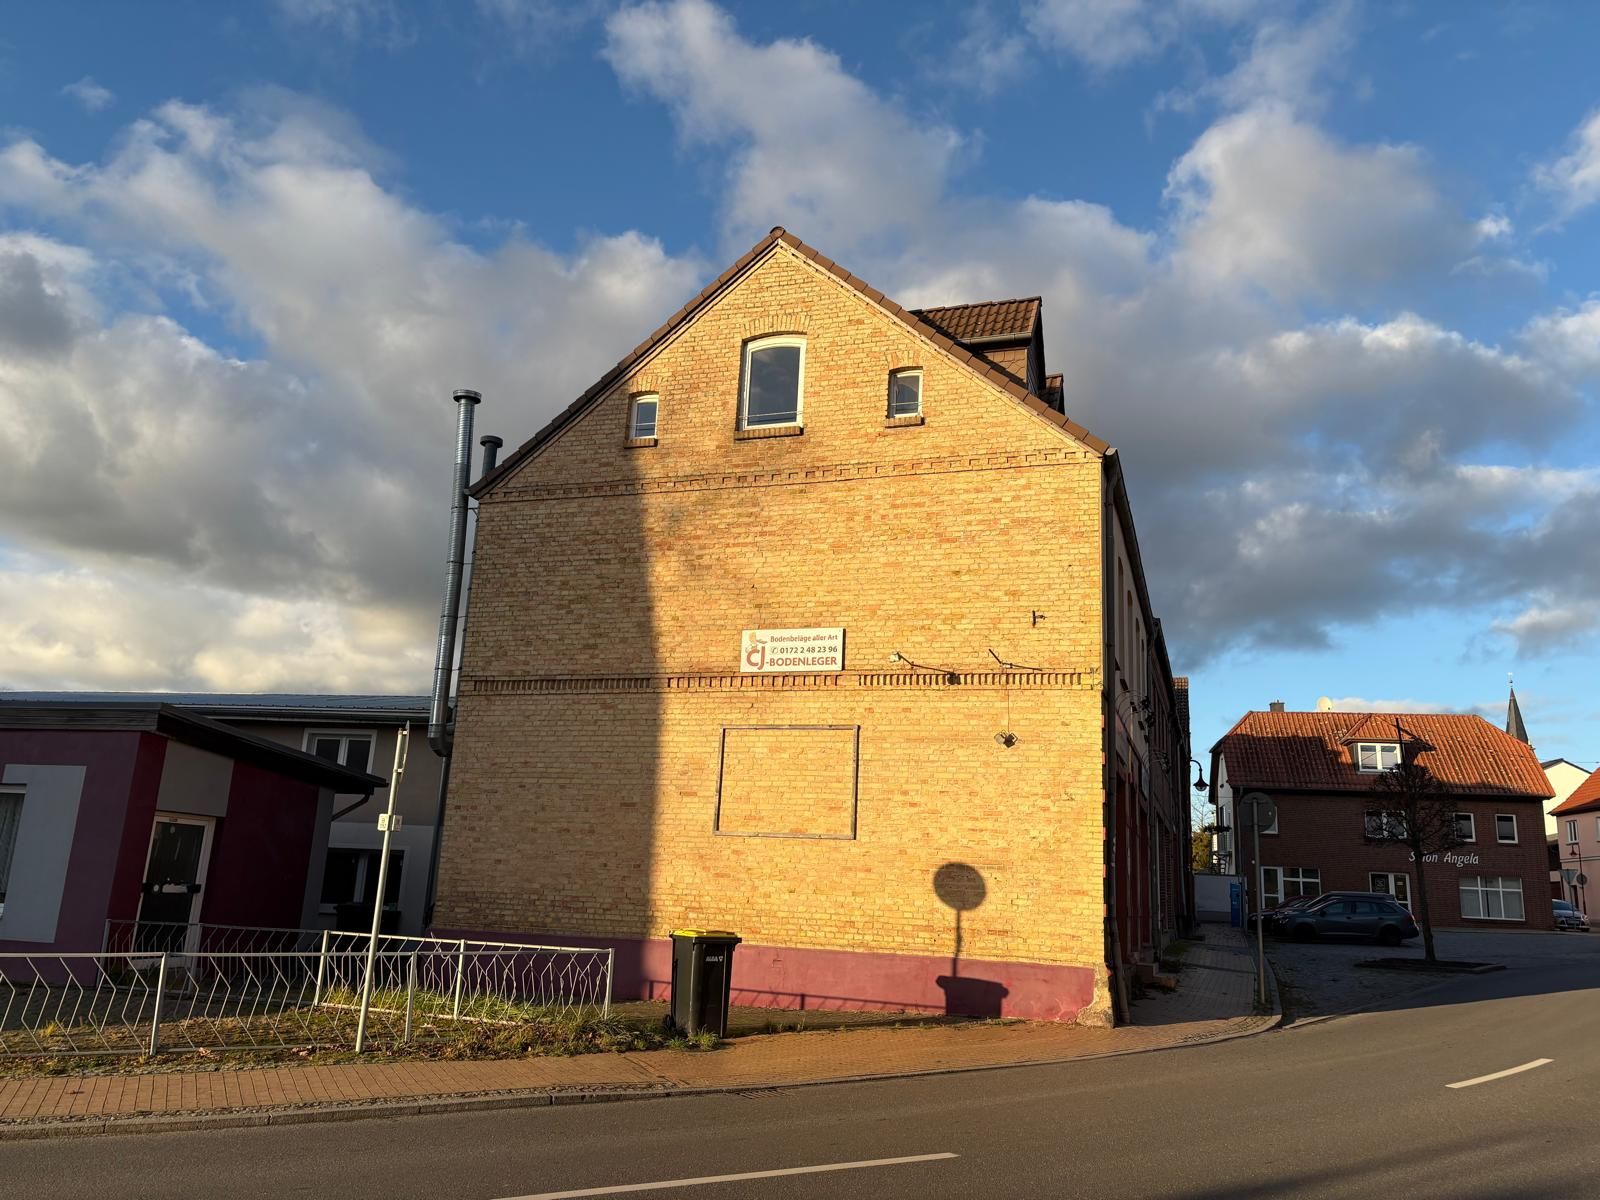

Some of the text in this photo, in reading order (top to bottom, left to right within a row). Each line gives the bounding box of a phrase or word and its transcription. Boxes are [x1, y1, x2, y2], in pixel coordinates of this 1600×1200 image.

[770, 635, 811, 643] Bodenbeläge
[1409, 851, 1479, 867] Slon Angela
